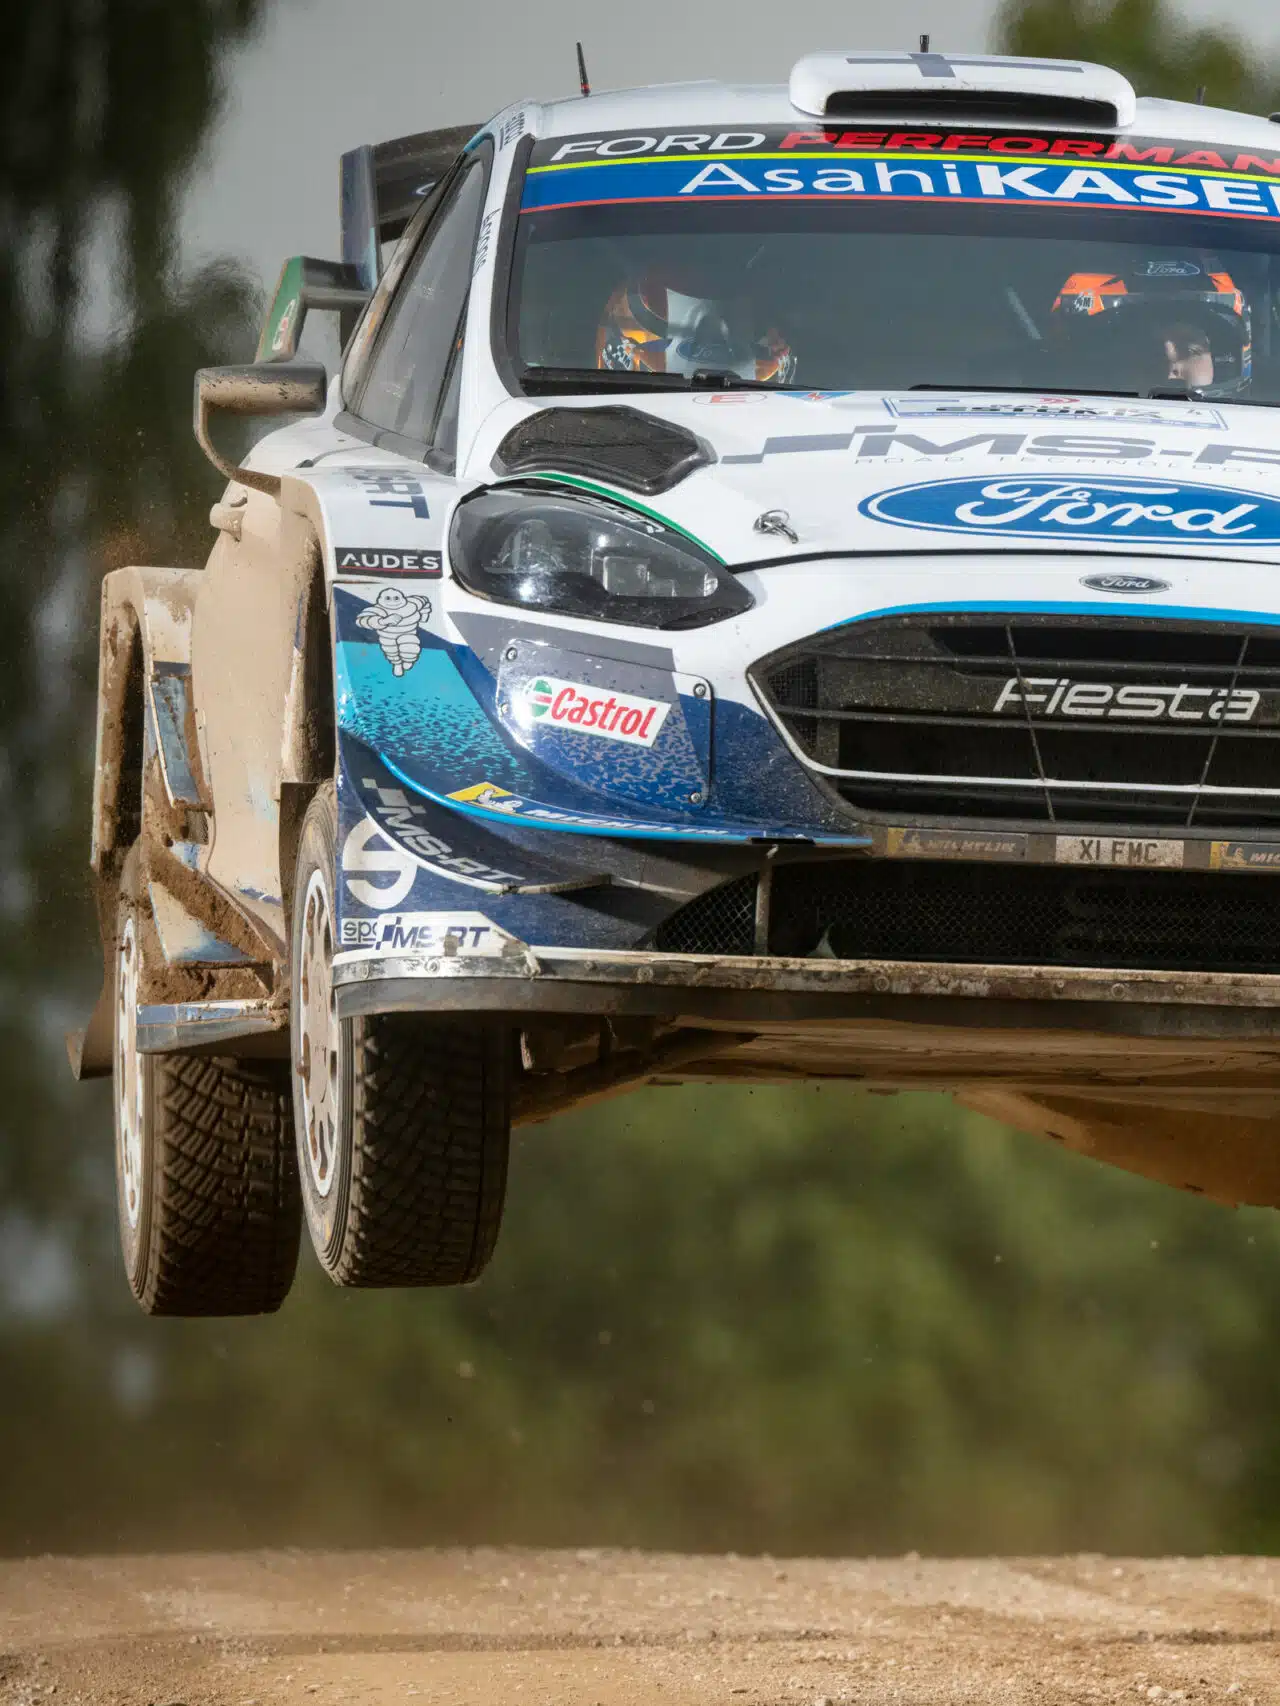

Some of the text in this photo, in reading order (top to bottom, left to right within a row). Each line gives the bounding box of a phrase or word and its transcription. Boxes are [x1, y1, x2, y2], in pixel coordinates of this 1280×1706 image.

[551, 131, 766, 161] FORD
[953, 479, 1259, 537] Ford
[340, 552, 441, 571] AUDES
[1100, 575, 1150, 589] Ford
[991, 676, 1262, 722] Fiesta
[551, 687, 657, 740] Castrol
[1111, 840, 1159, 866] FMC
[390, 925, 491, 949] MSRT
